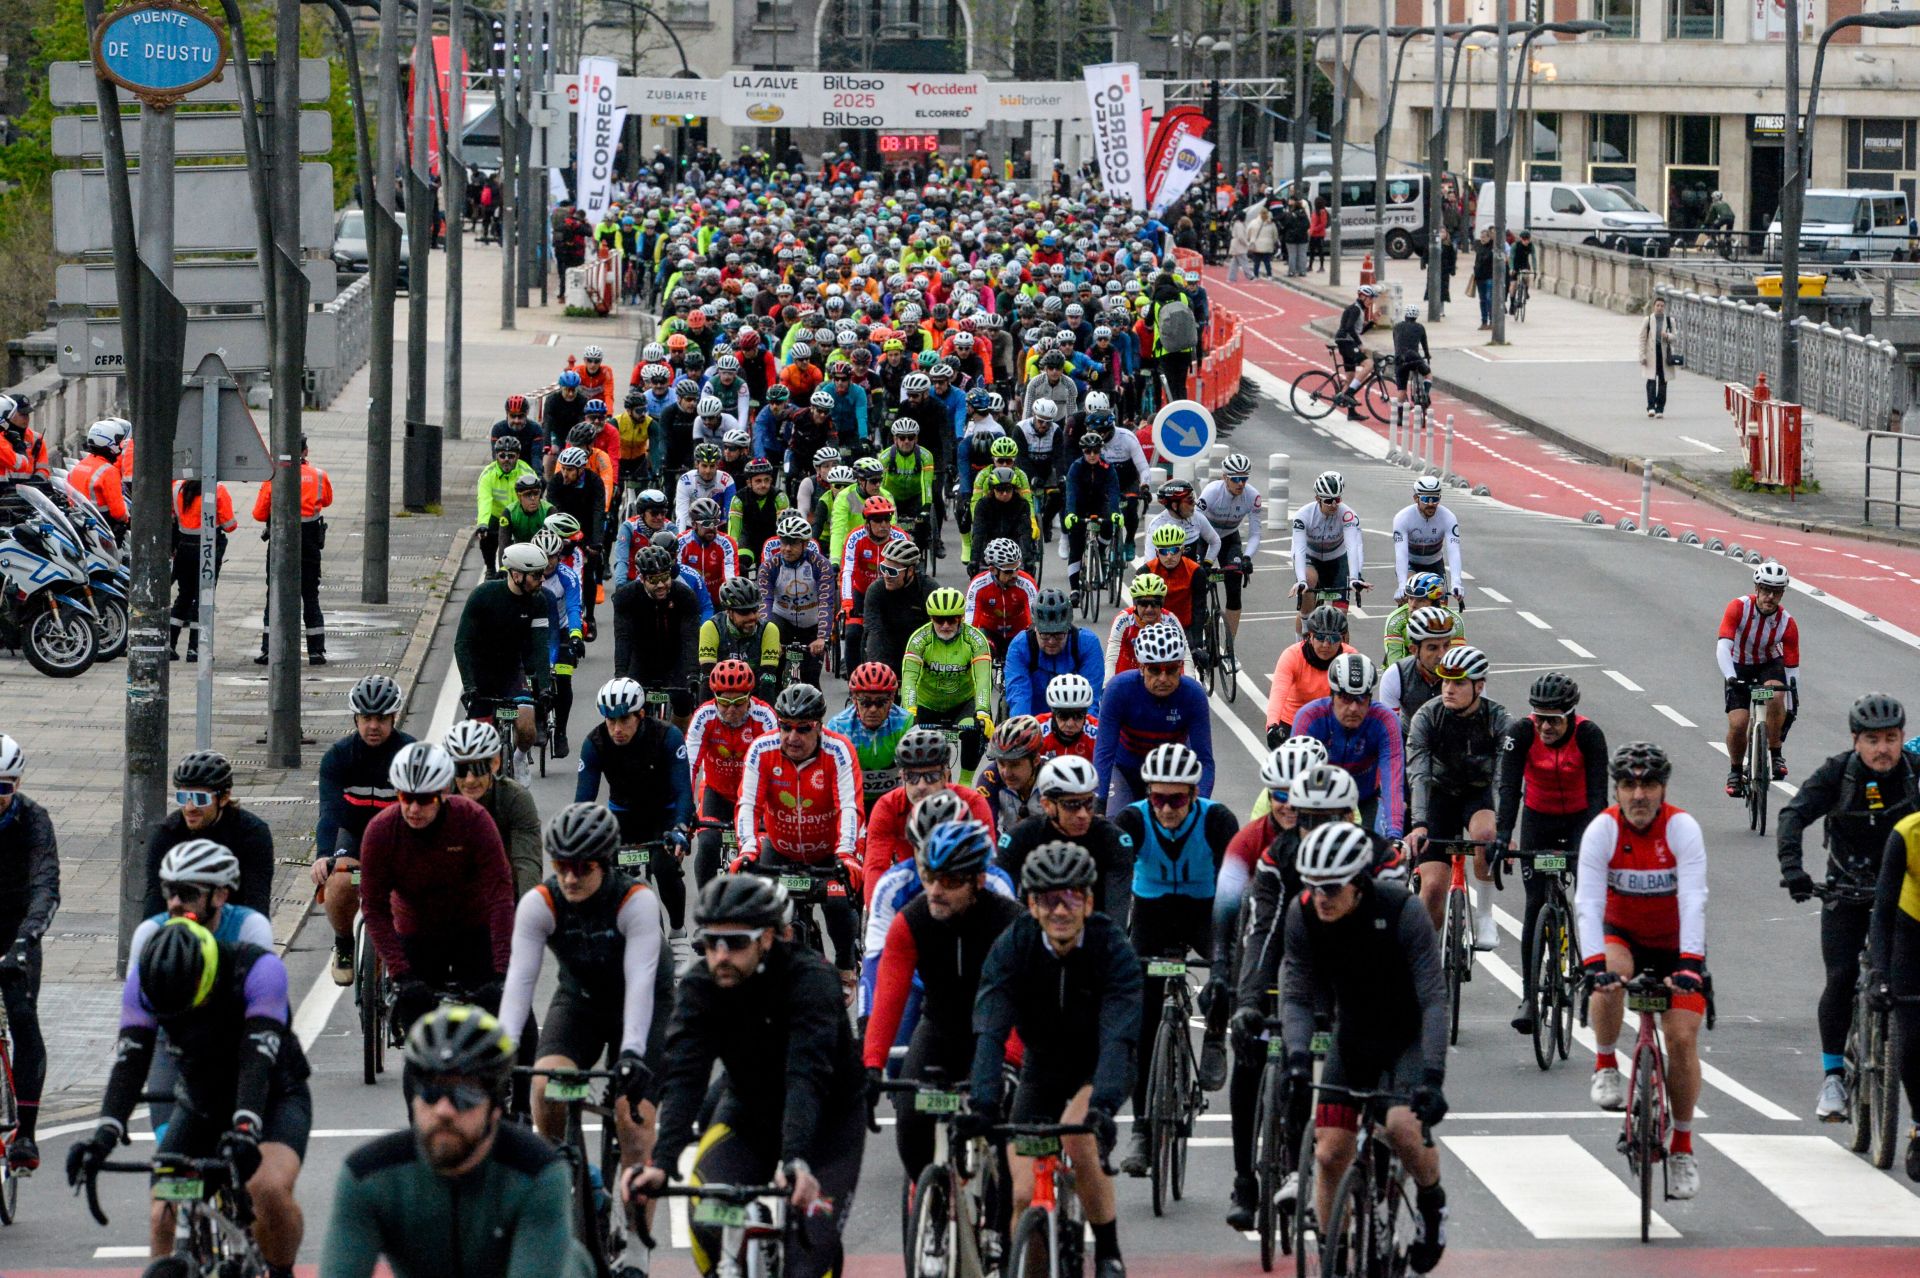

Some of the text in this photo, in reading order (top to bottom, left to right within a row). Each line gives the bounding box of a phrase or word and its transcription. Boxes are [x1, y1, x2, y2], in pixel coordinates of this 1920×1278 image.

[133, 11, 188, 28] PUENTE
[108, 41, 212, 62] DE DEUSTU
[733, 76, 799, 90] LA SALVE
[823, 75, 884, 90] Bilbao
[646, 89, 708, 101] ZUBIARTE
[922, 83, 977, 95] Occident
[833, 93, 875, 108] 2025
[823, 111, 884, 126] Bilbao
[915, 109, 969, 118] EL CORREO
[1754, 115, 1784, 129] FITNESS
[589, 85, 613, 211] EL CORREO
[1864, 137, 1903, 147] FITNESS PARK
[930, 661, 958, 672] Nuez
[1757, 690, 1773, 698] 2713
[626, 852, 649, 862] 3215
[1542, 859, 1565, 868] 4976
[787, 879, 810, 888] 5996
